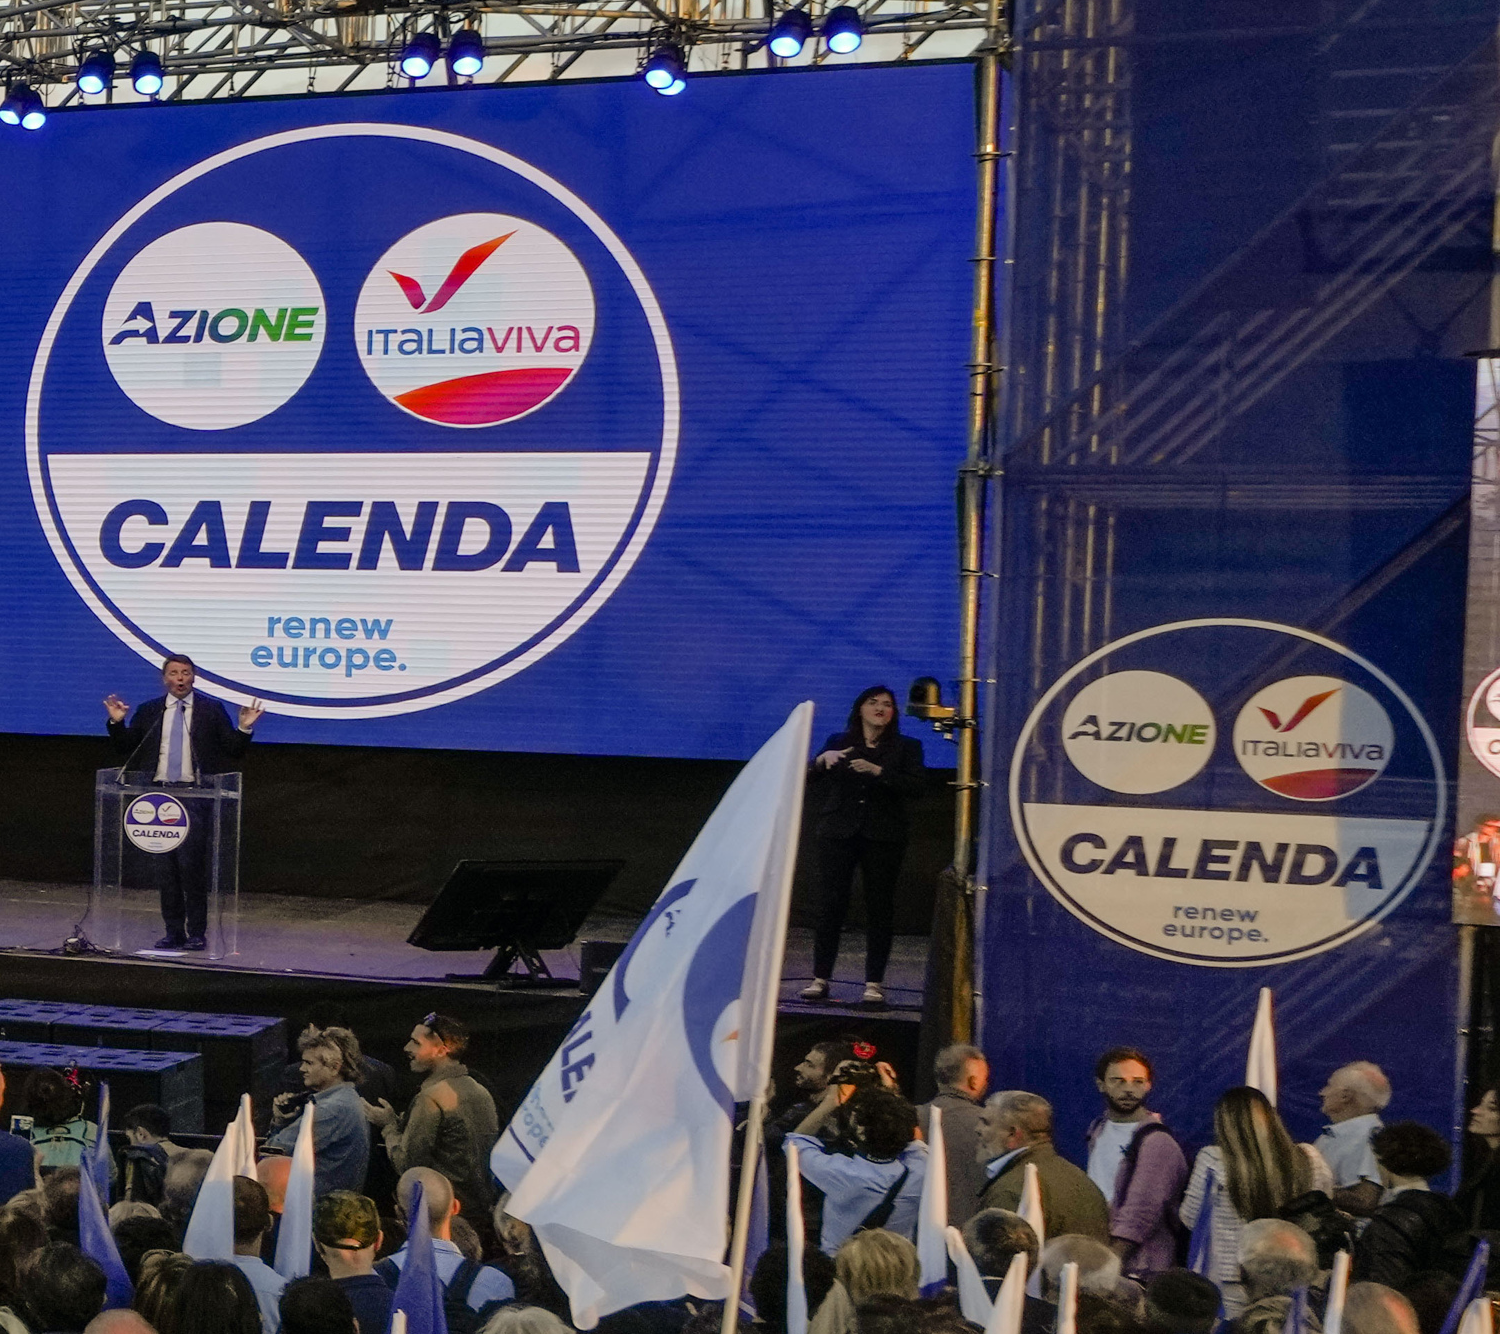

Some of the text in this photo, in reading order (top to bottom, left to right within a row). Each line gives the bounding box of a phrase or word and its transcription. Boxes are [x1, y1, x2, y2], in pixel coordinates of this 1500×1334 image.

[109, 301, 319, 345] AZIONE
[99, 499, 581, 573] CALENDA
[266, 615, 393, 641] renew
[250, 645, 407, 678] europe.
[1067, 714, 1210, 745] AZIONE
[132, 829, 180, 839] CALENDA
[1059, 832, 1384, 890] CALENDA
[1172, 905, 1259, 923] renew
[1163, 923, 1269, 945] europe.
